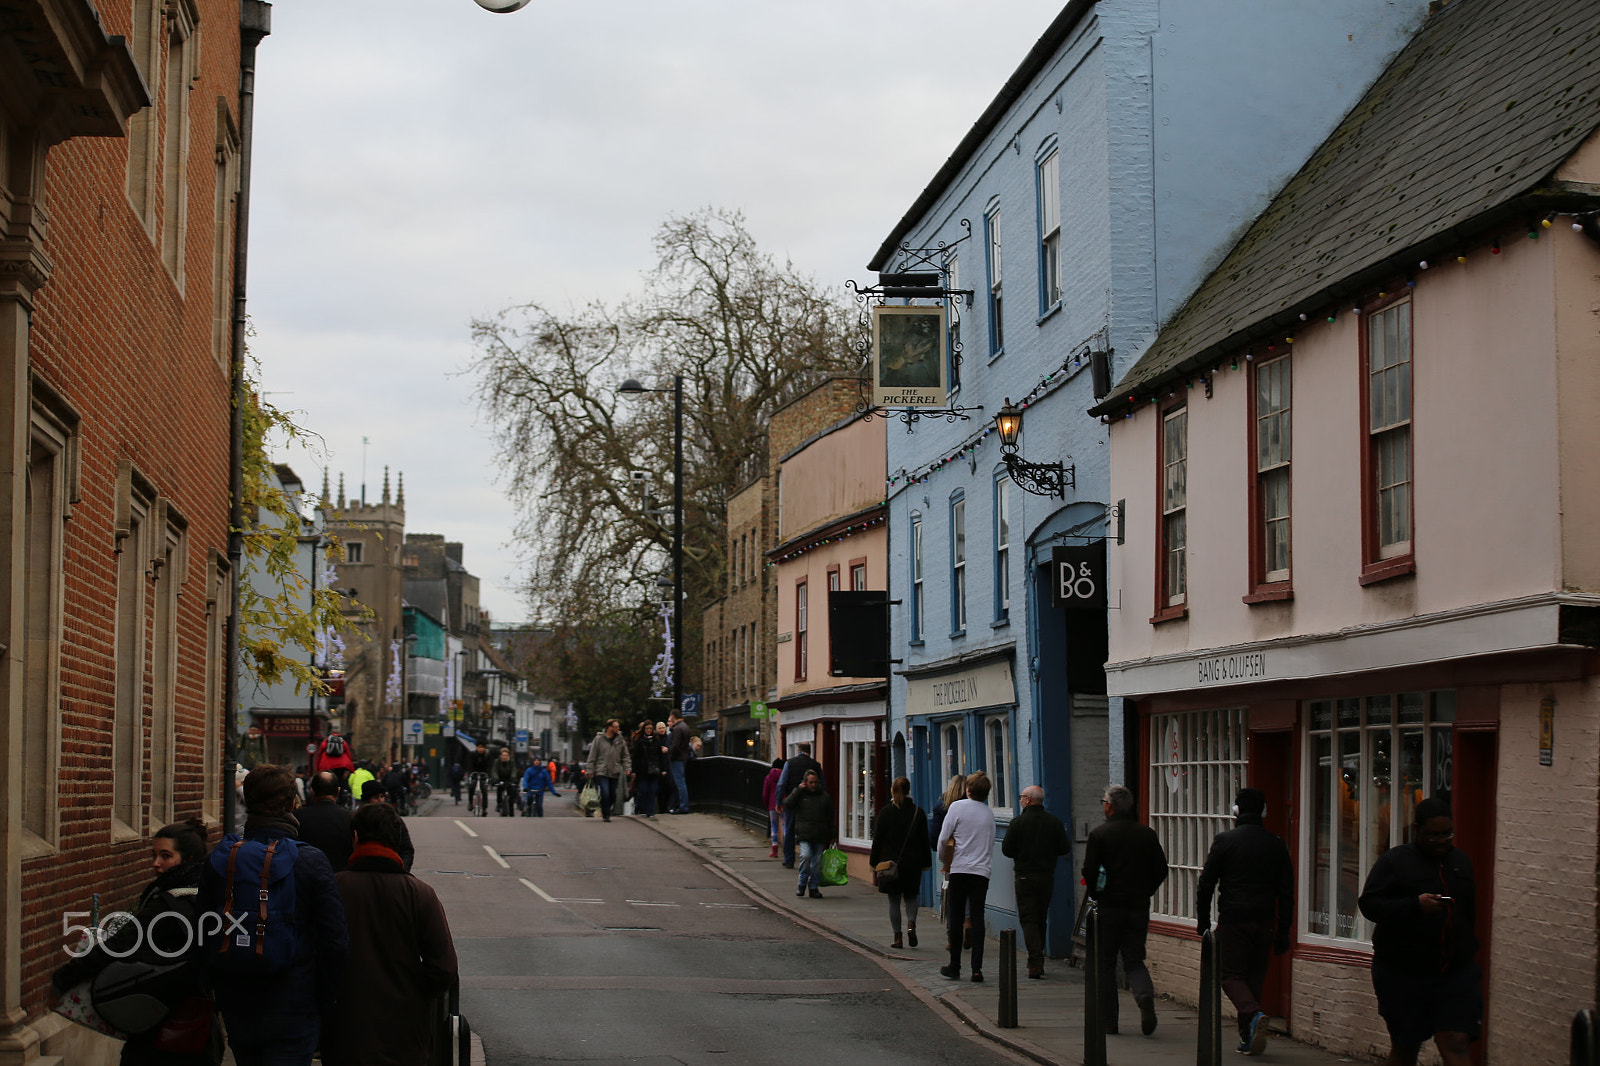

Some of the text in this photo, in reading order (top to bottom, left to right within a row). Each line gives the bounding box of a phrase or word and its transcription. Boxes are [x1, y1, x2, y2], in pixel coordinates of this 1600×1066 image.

[883, 395, 938, 404] PICKEREL
[1060, 561, 1095, 599] B&O
[1198, 653, 1265, 682] BANG & OLUFSEN
[933, 676, 978, 706] THE PICKEREL INN
